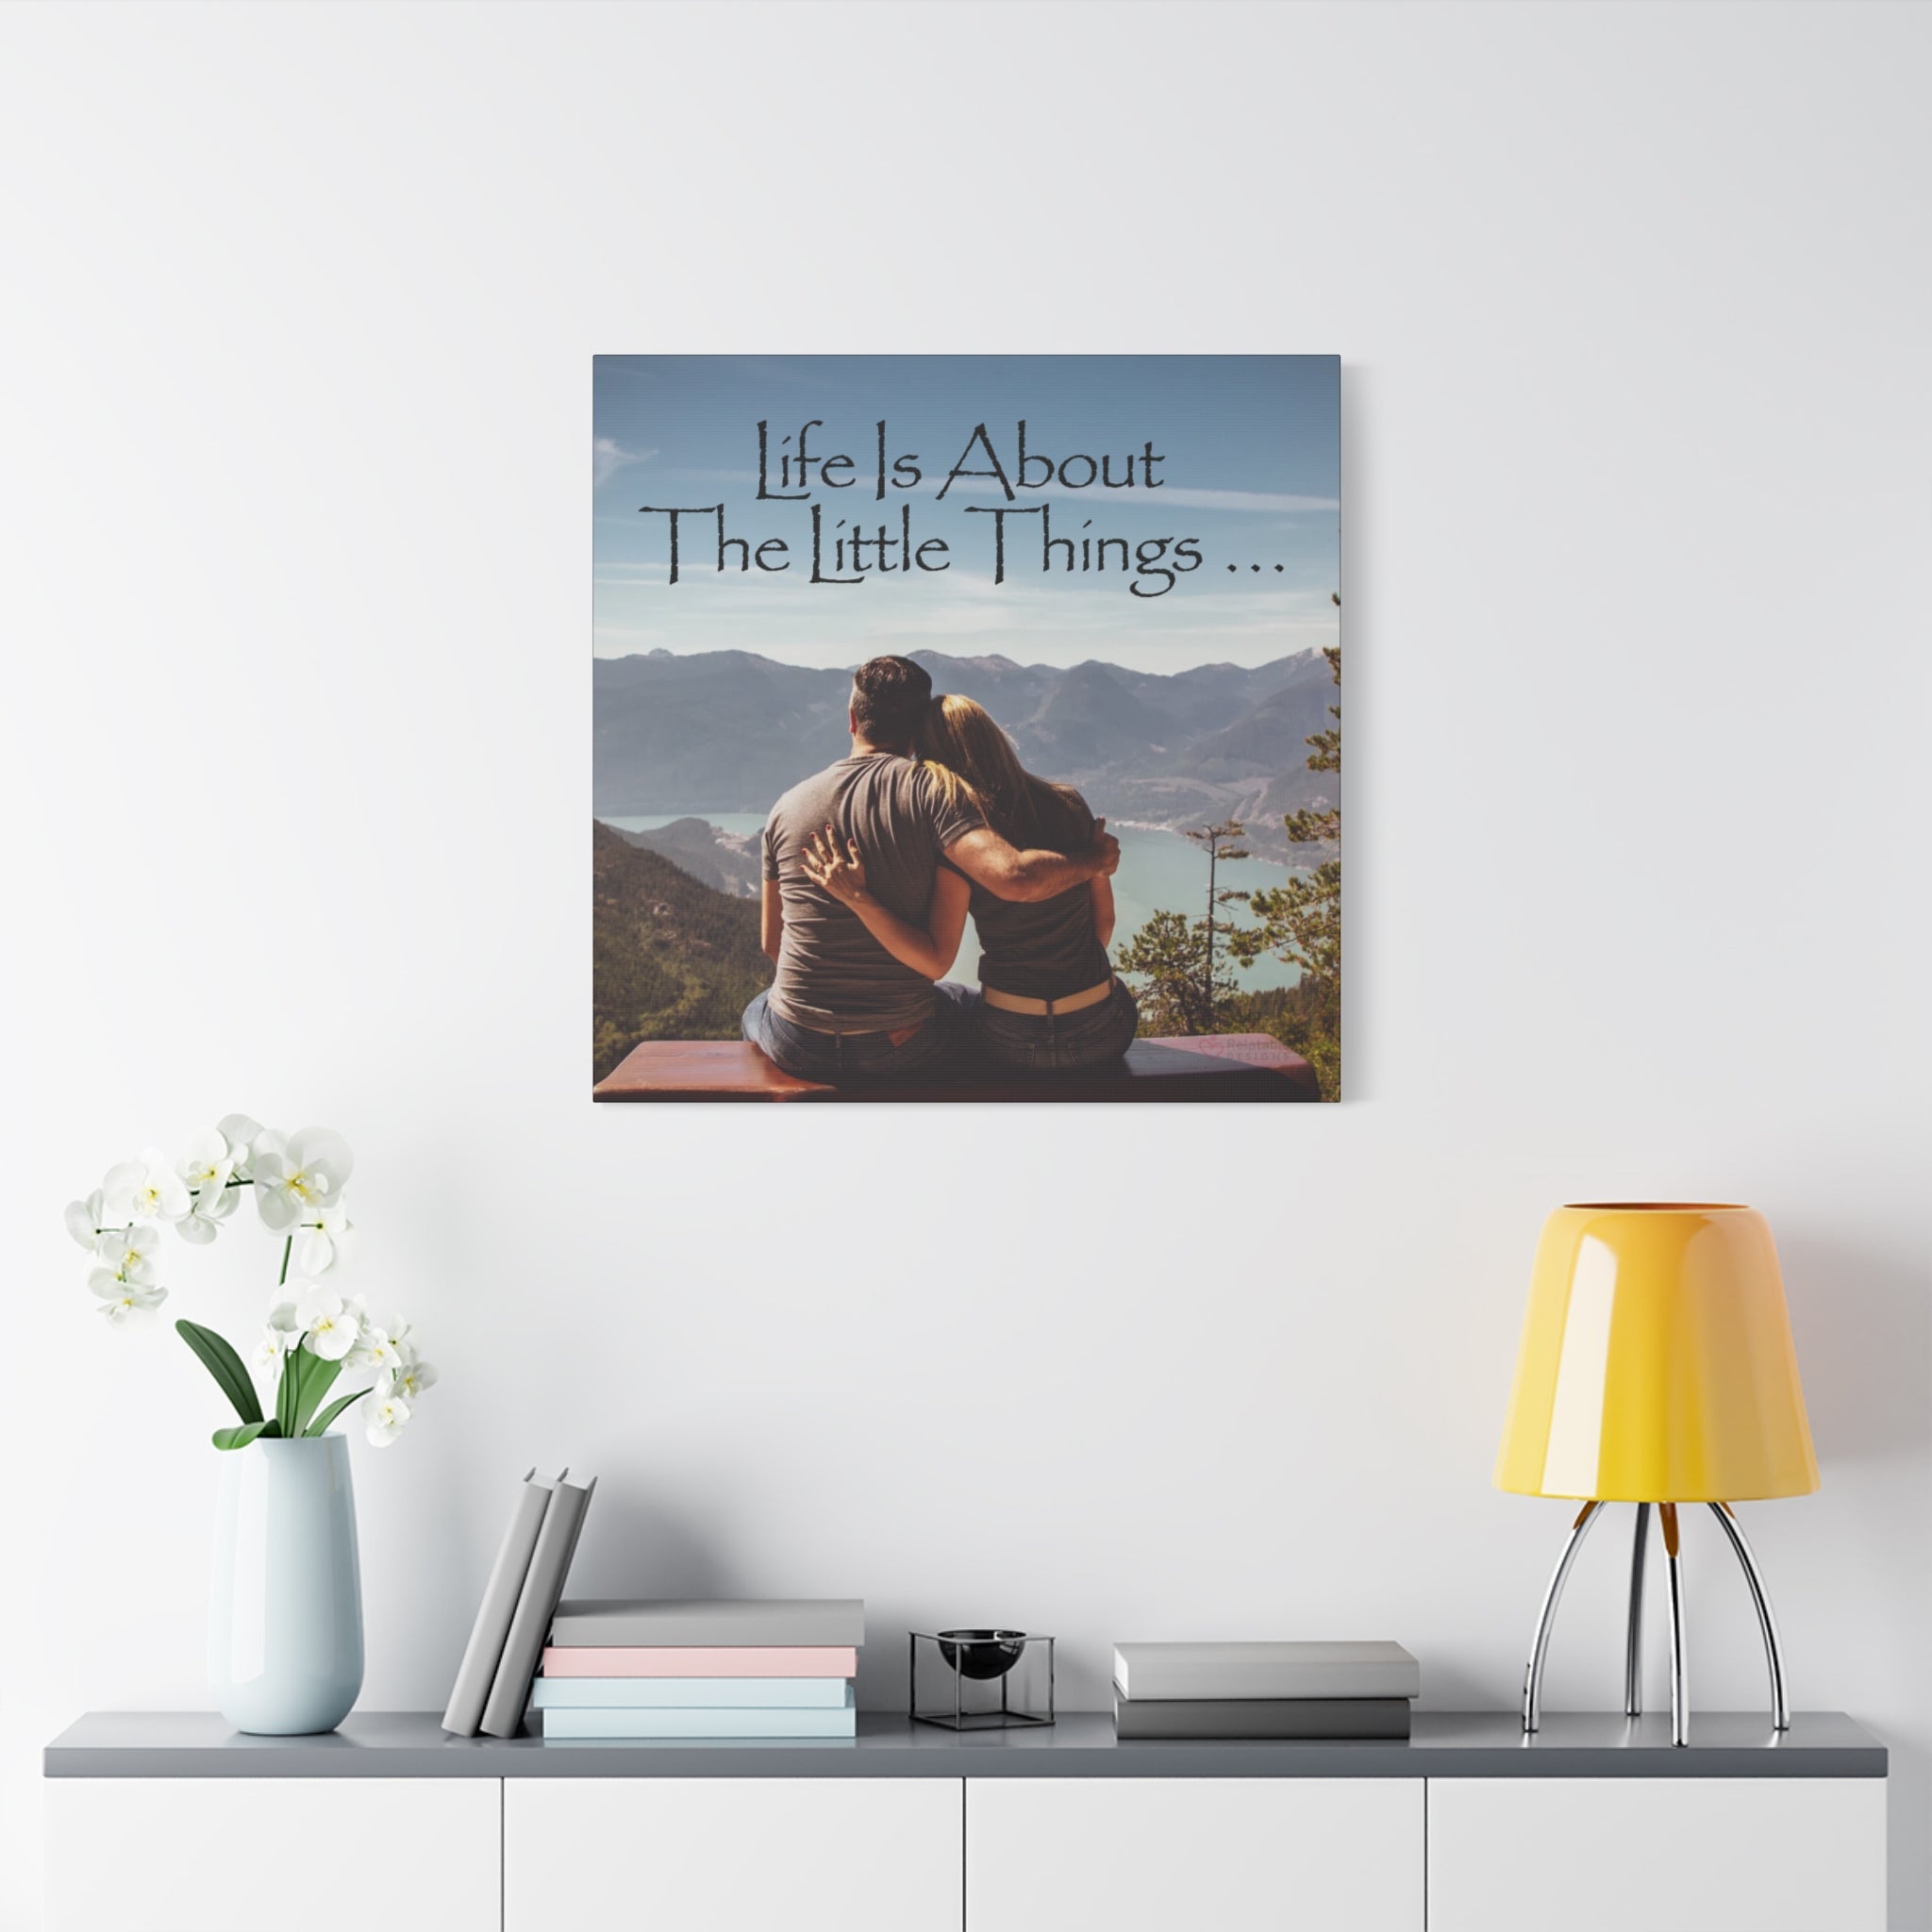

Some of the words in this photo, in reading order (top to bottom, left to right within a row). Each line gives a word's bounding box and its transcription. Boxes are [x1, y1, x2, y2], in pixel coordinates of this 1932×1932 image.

[756, 420, 856, 500] Life
[875, 420, 922, 501] Is
[935, 419, 1166, 502] About
[639, 503, 790, 585] The
[809, 504, 950, 584] Little
[964, 503, 1203, 598] Things
